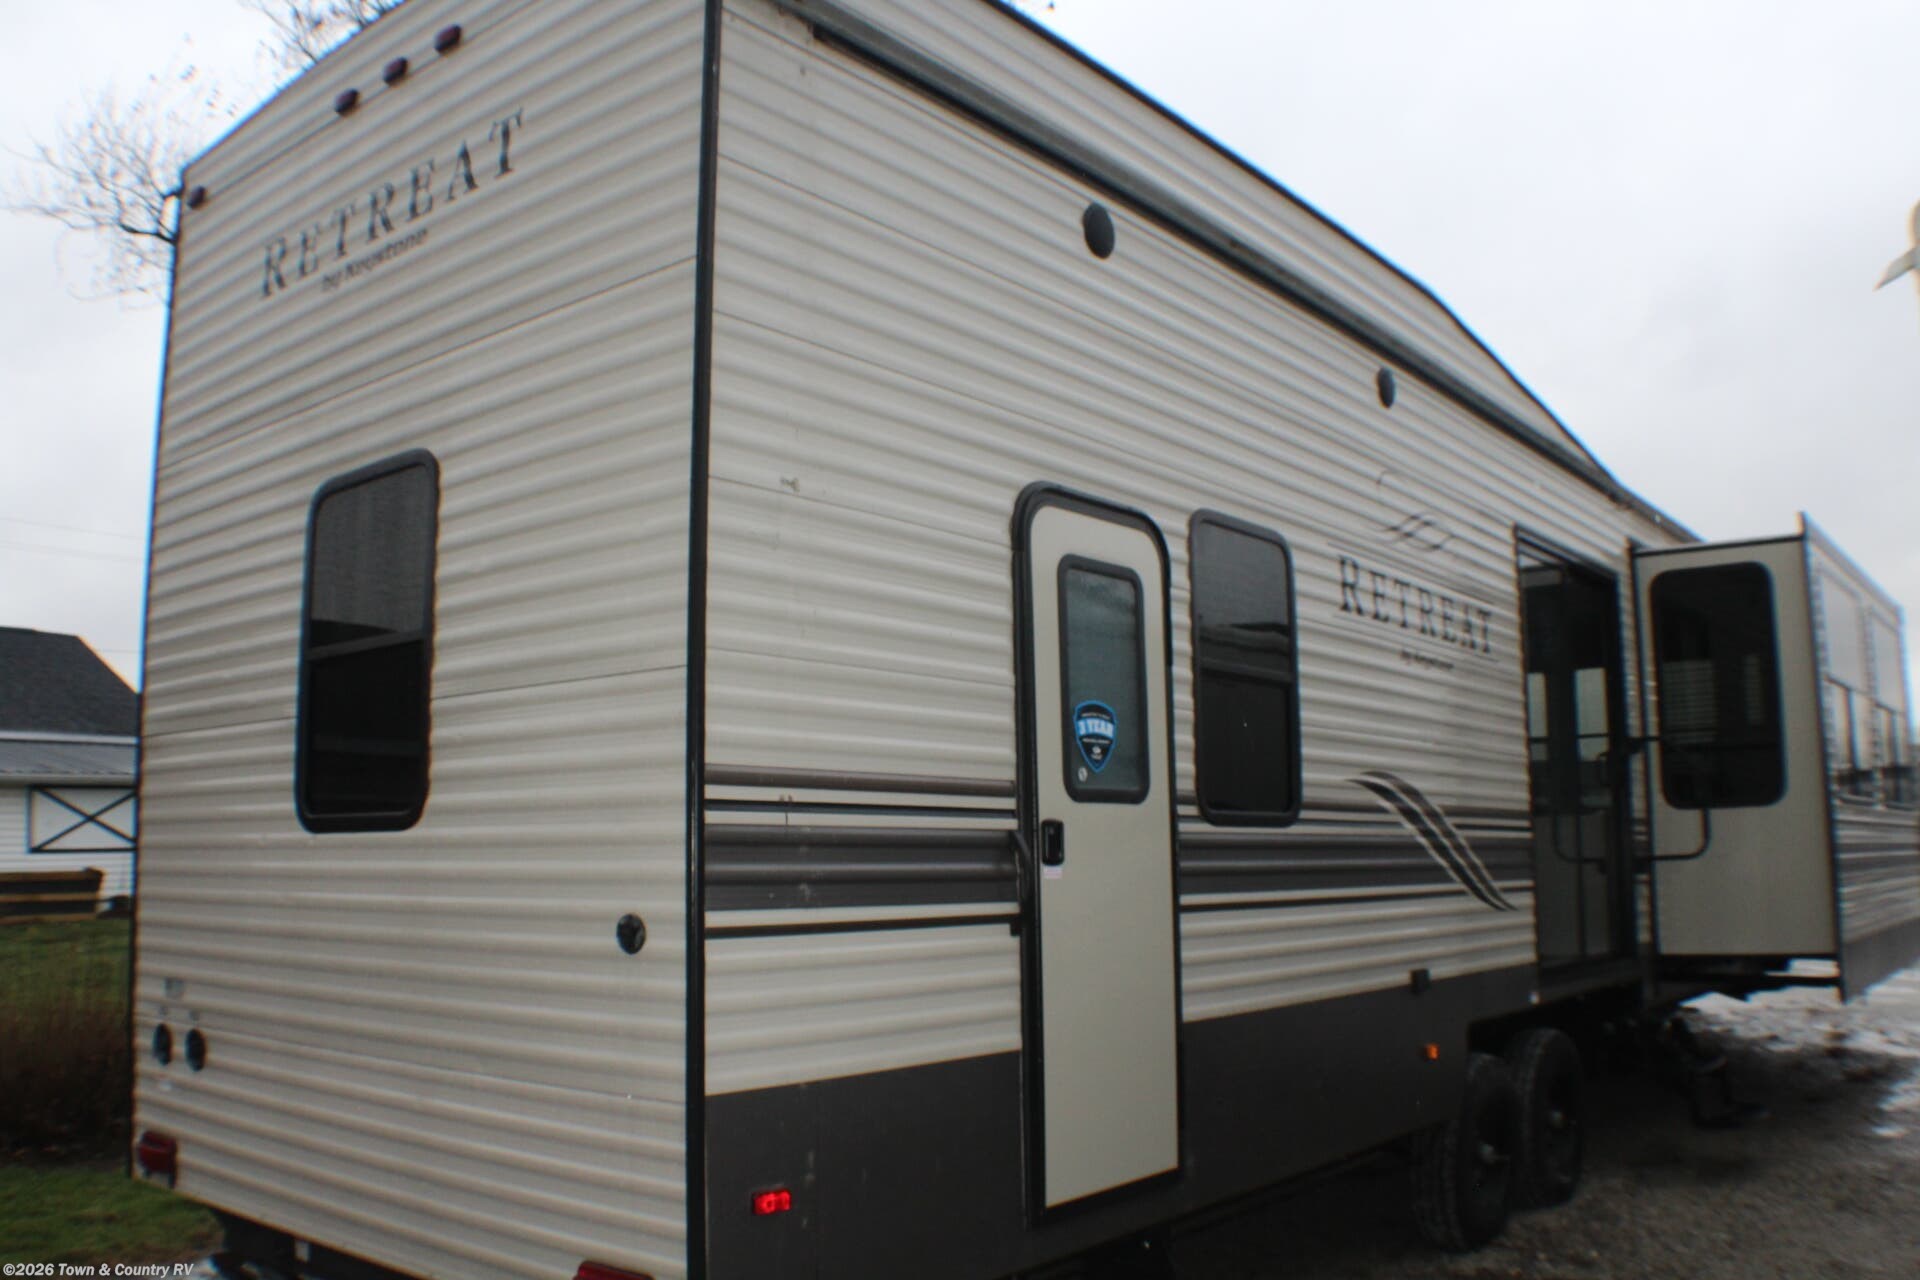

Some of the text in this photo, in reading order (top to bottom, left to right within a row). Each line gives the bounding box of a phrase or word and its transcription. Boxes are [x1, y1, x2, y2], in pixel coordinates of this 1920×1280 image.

[260, 109, 524, 298] RETREAT
[1340, 555, 1491, 653] RETREAT
[1087, 718, 1114, 737] YEAR
